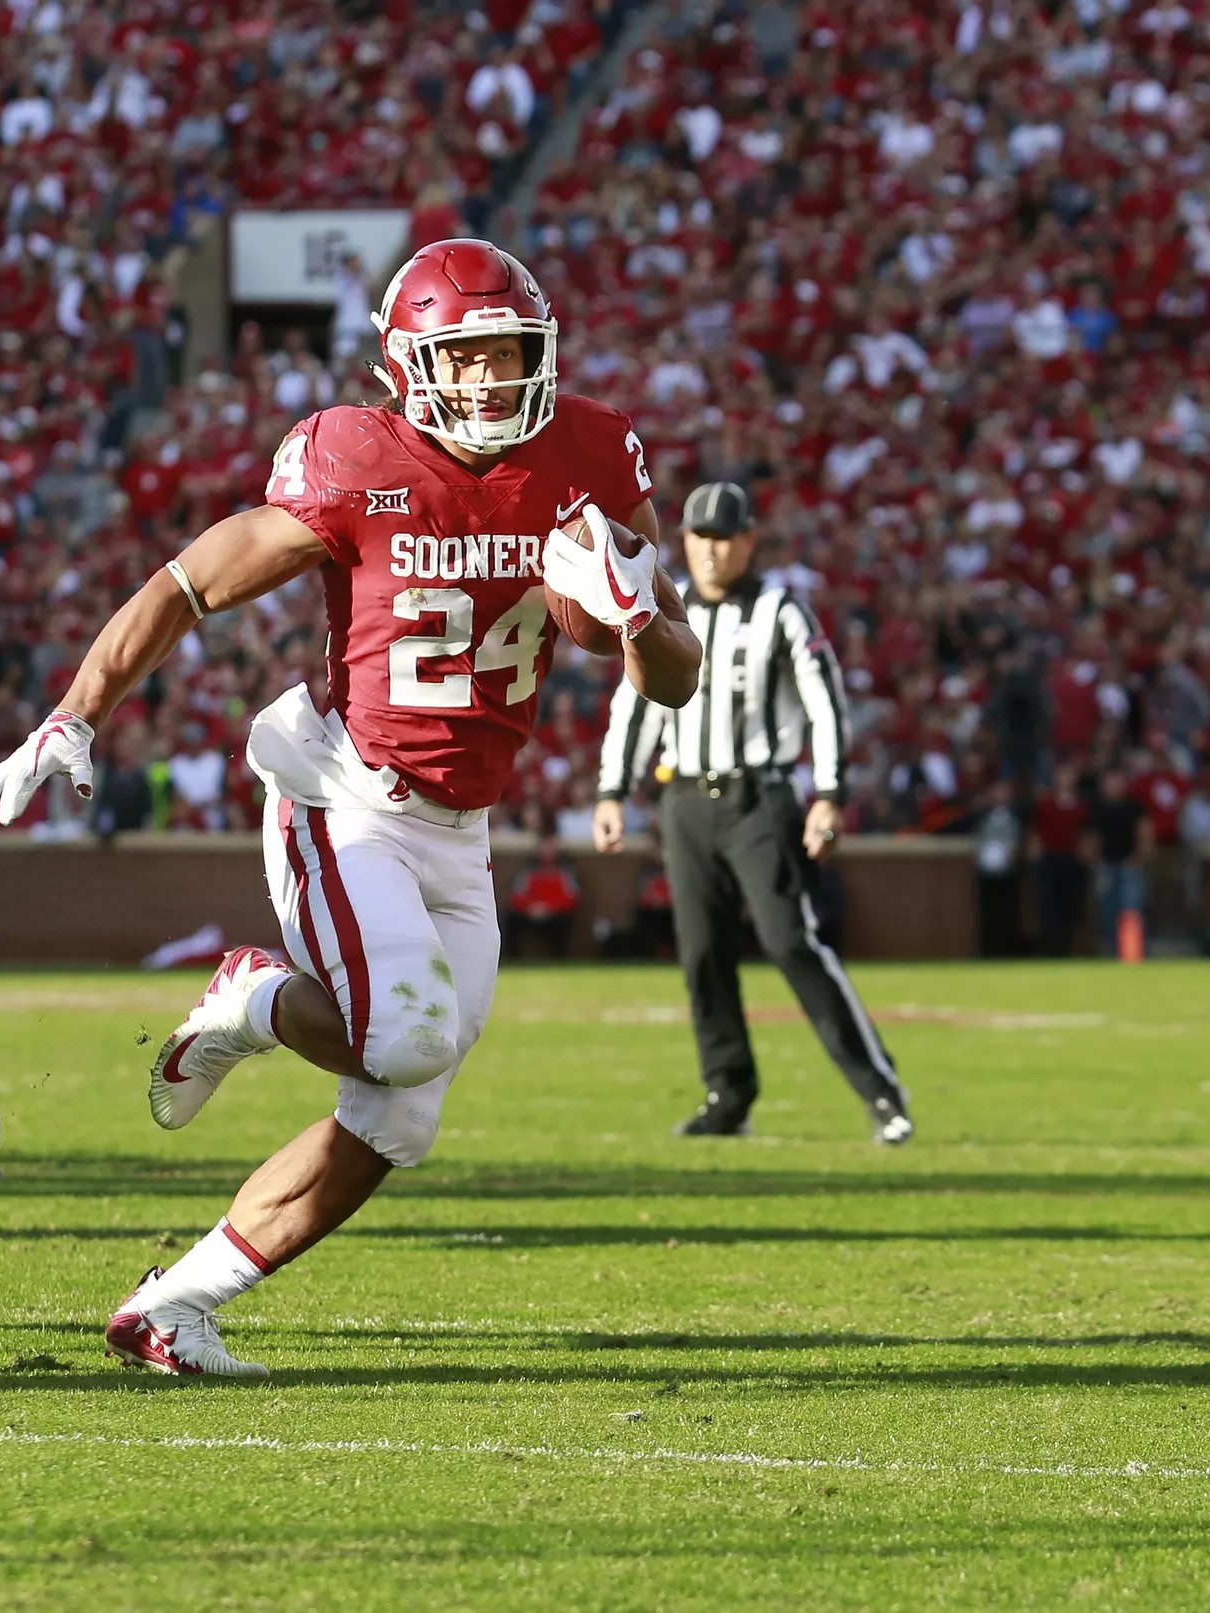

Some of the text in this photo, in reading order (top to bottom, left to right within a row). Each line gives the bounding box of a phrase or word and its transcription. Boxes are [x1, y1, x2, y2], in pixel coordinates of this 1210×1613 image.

[265, 433, 308, 496] 4
[390, 533, 545, 580] SOONER
[389, 587, 548, 707] 24
